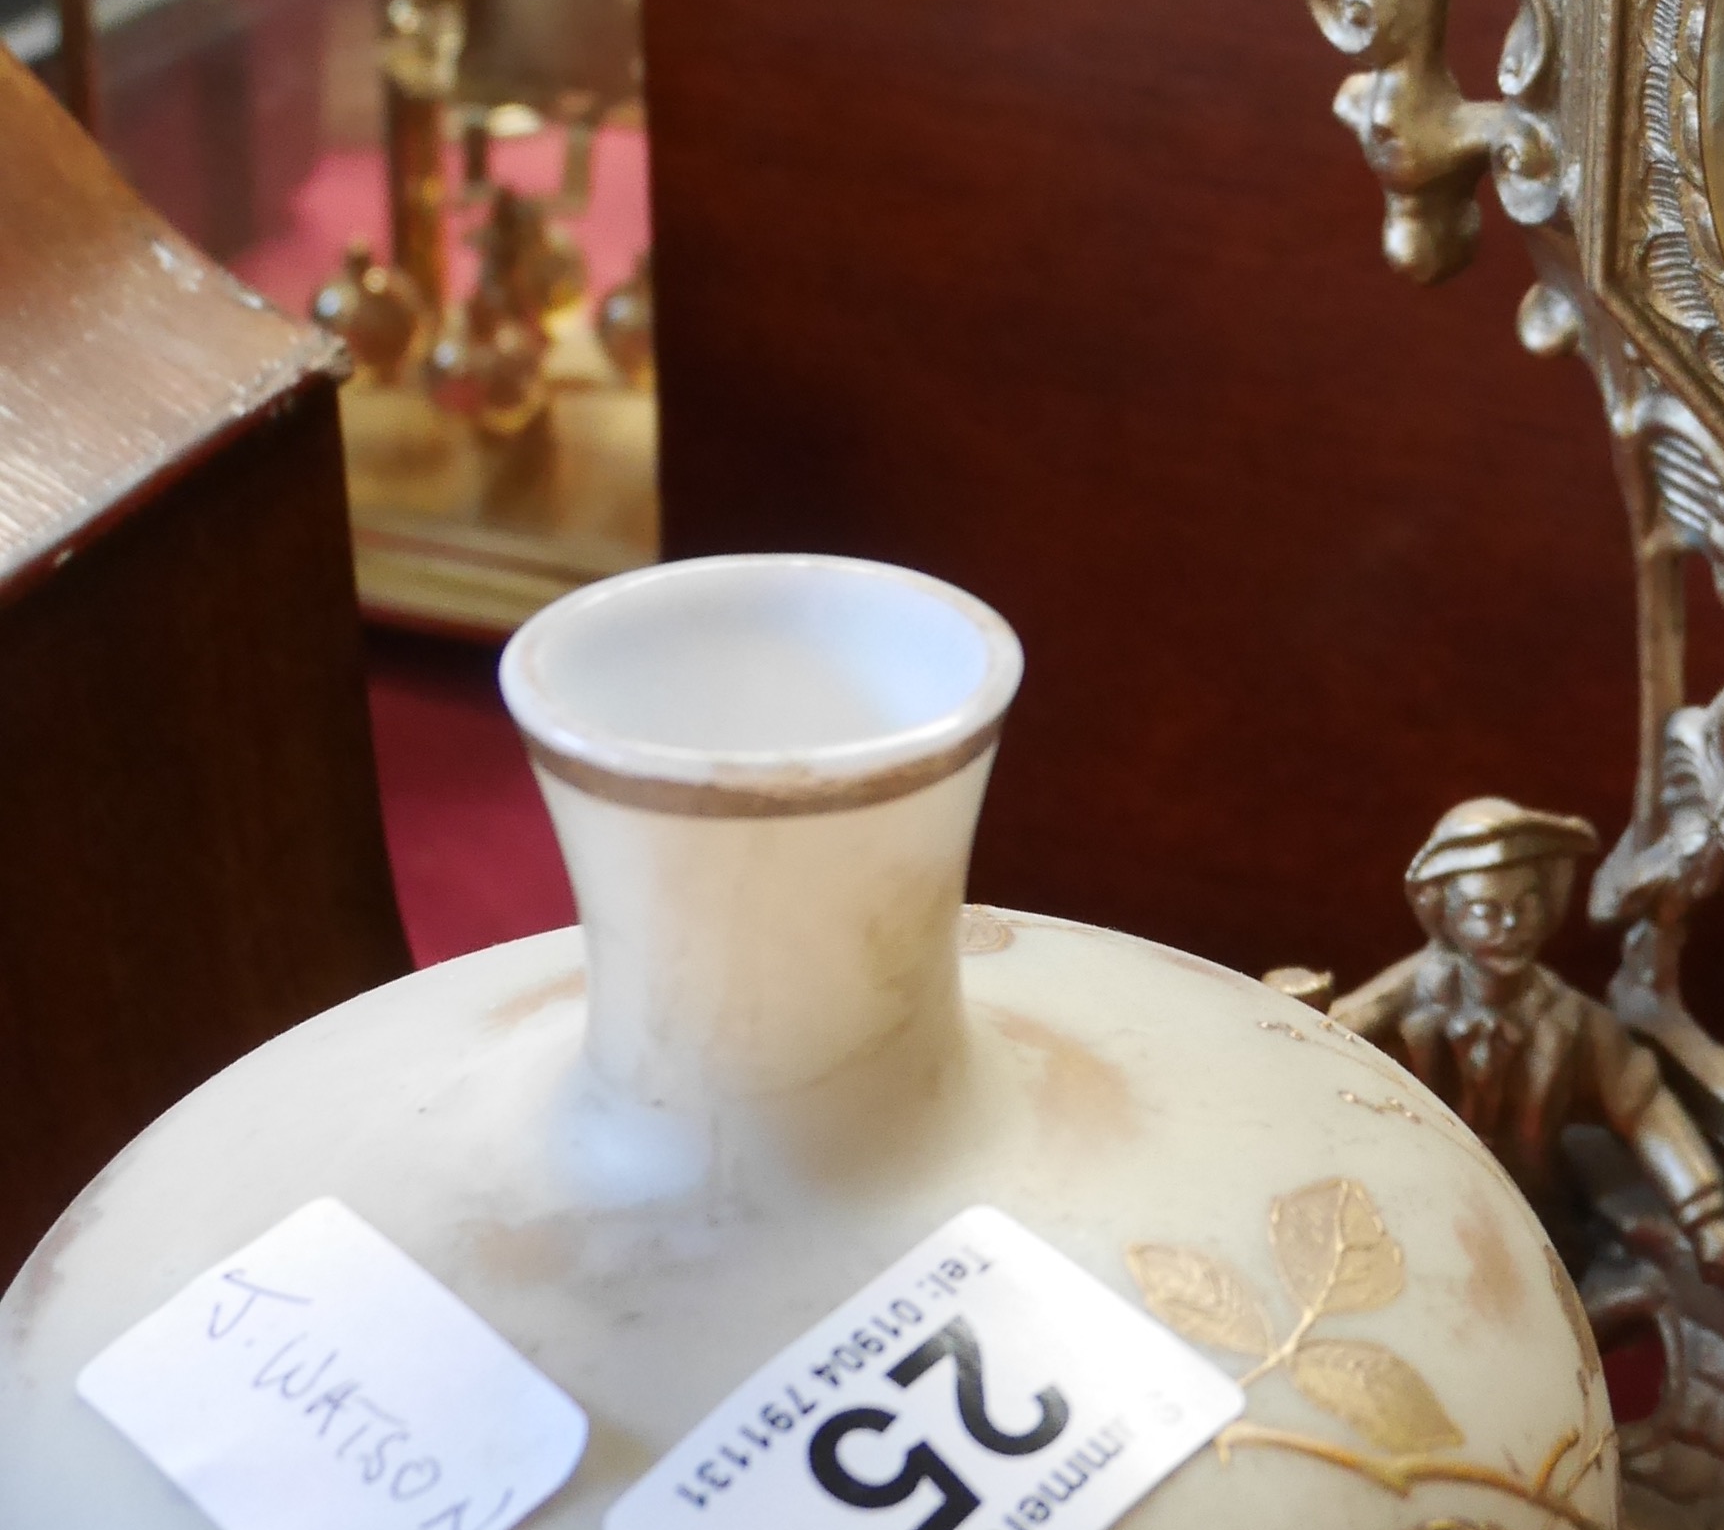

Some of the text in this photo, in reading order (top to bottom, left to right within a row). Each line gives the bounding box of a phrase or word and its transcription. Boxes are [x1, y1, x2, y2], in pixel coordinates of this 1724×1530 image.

[672, 1242, 994, 1511] Tel: 01904 791131
